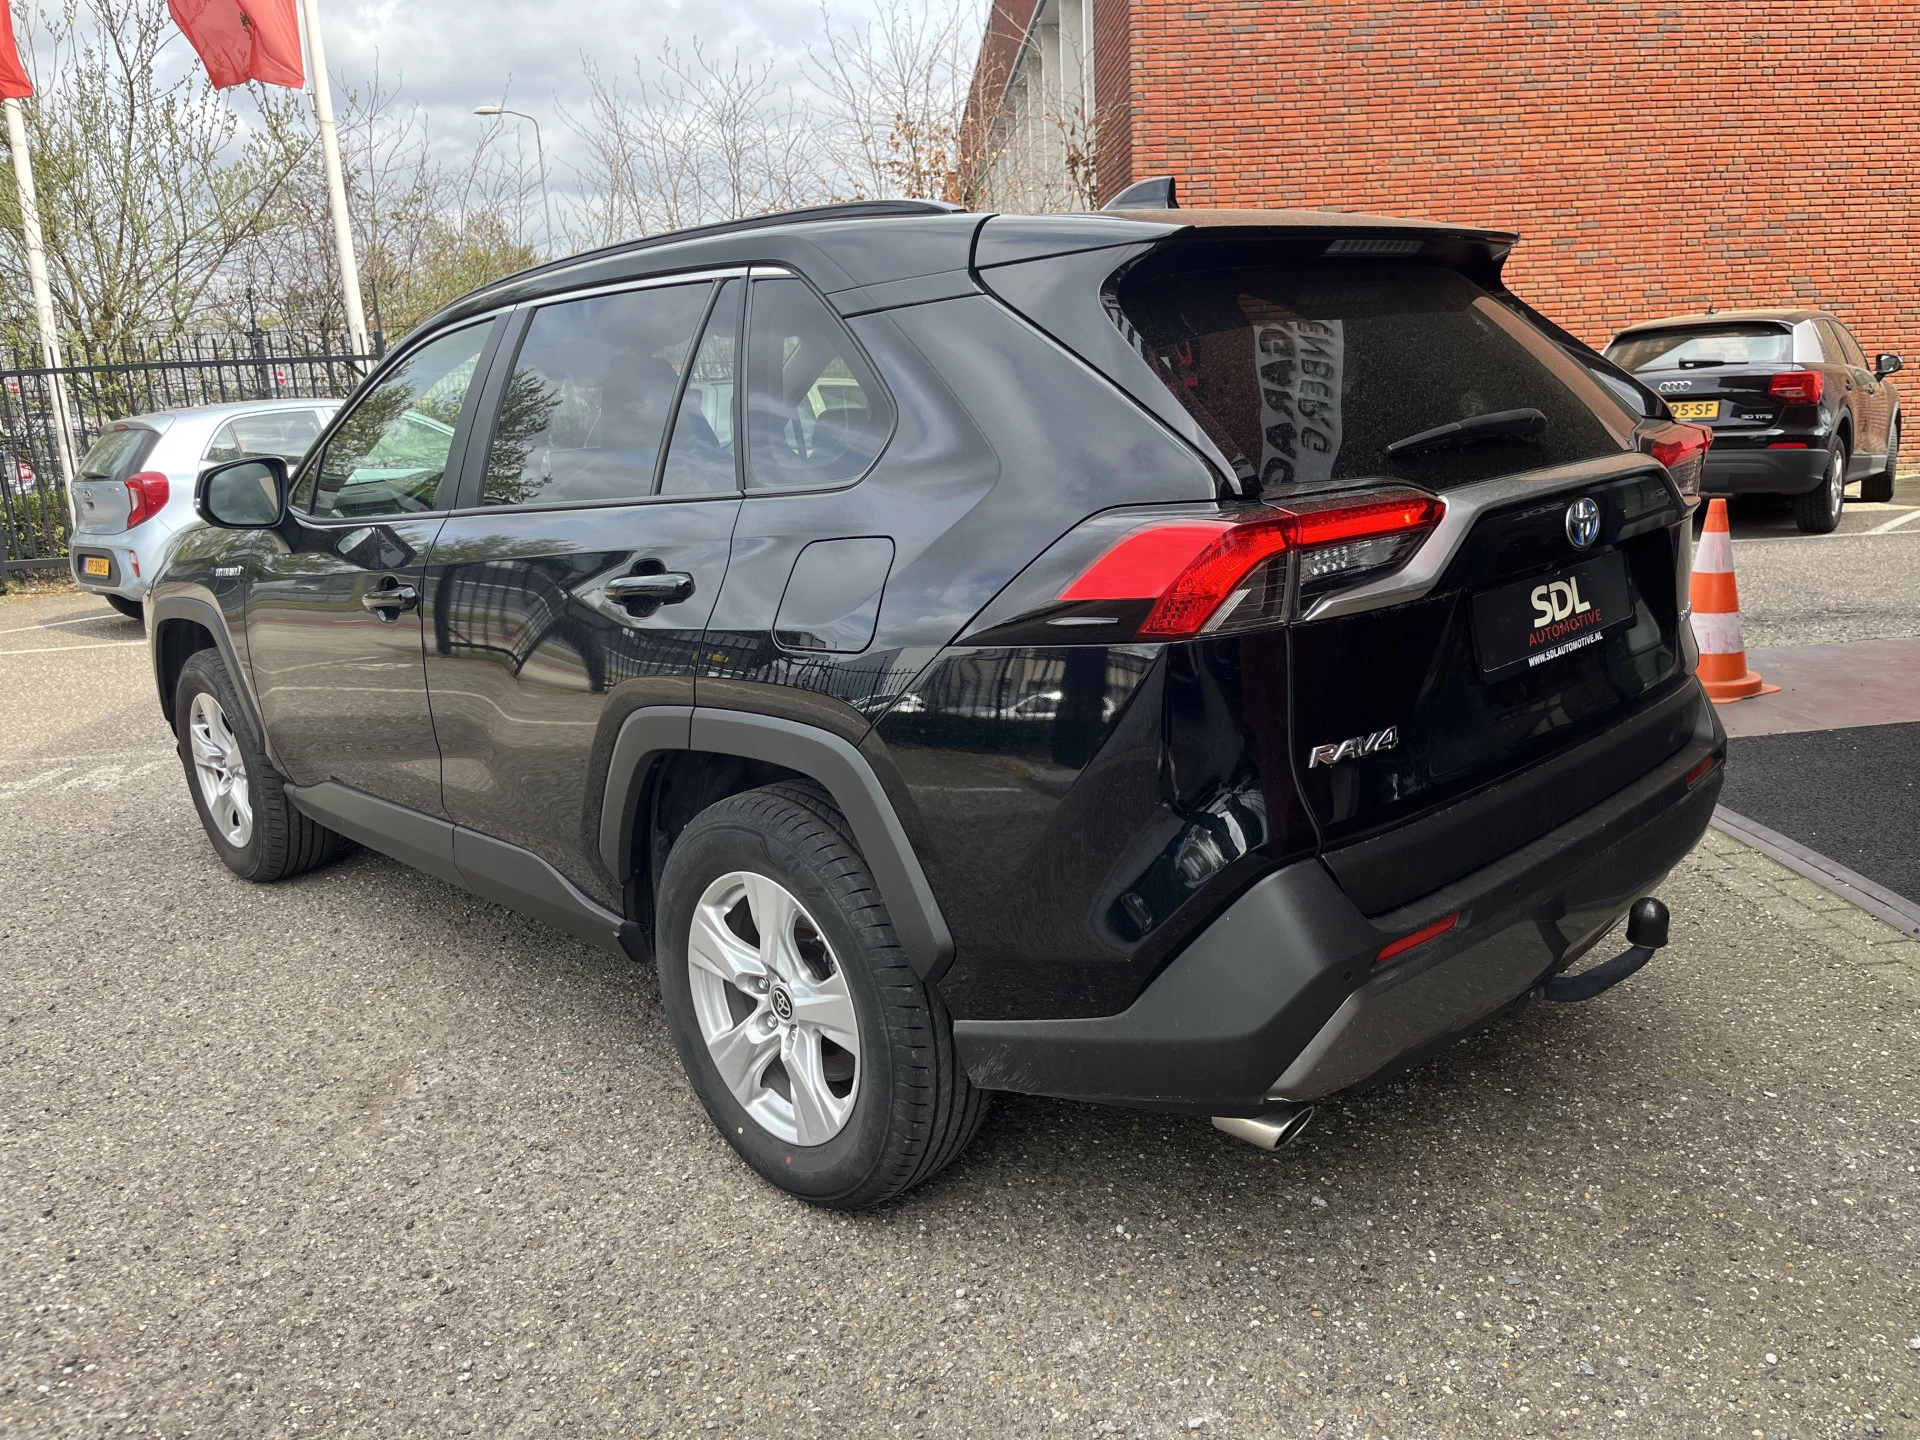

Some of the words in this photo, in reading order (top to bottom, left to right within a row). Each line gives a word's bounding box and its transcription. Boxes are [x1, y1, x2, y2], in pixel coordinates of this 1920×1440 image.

[1531, 576, 1591, 628] SDL
[1528, 608, 1603, 647] AUTOMOTIVE
[1528, 631, 1604, 667] WWW.SDLAUTOMOTIVE.NL
[1309, 726, 1399, 768] RAV4
